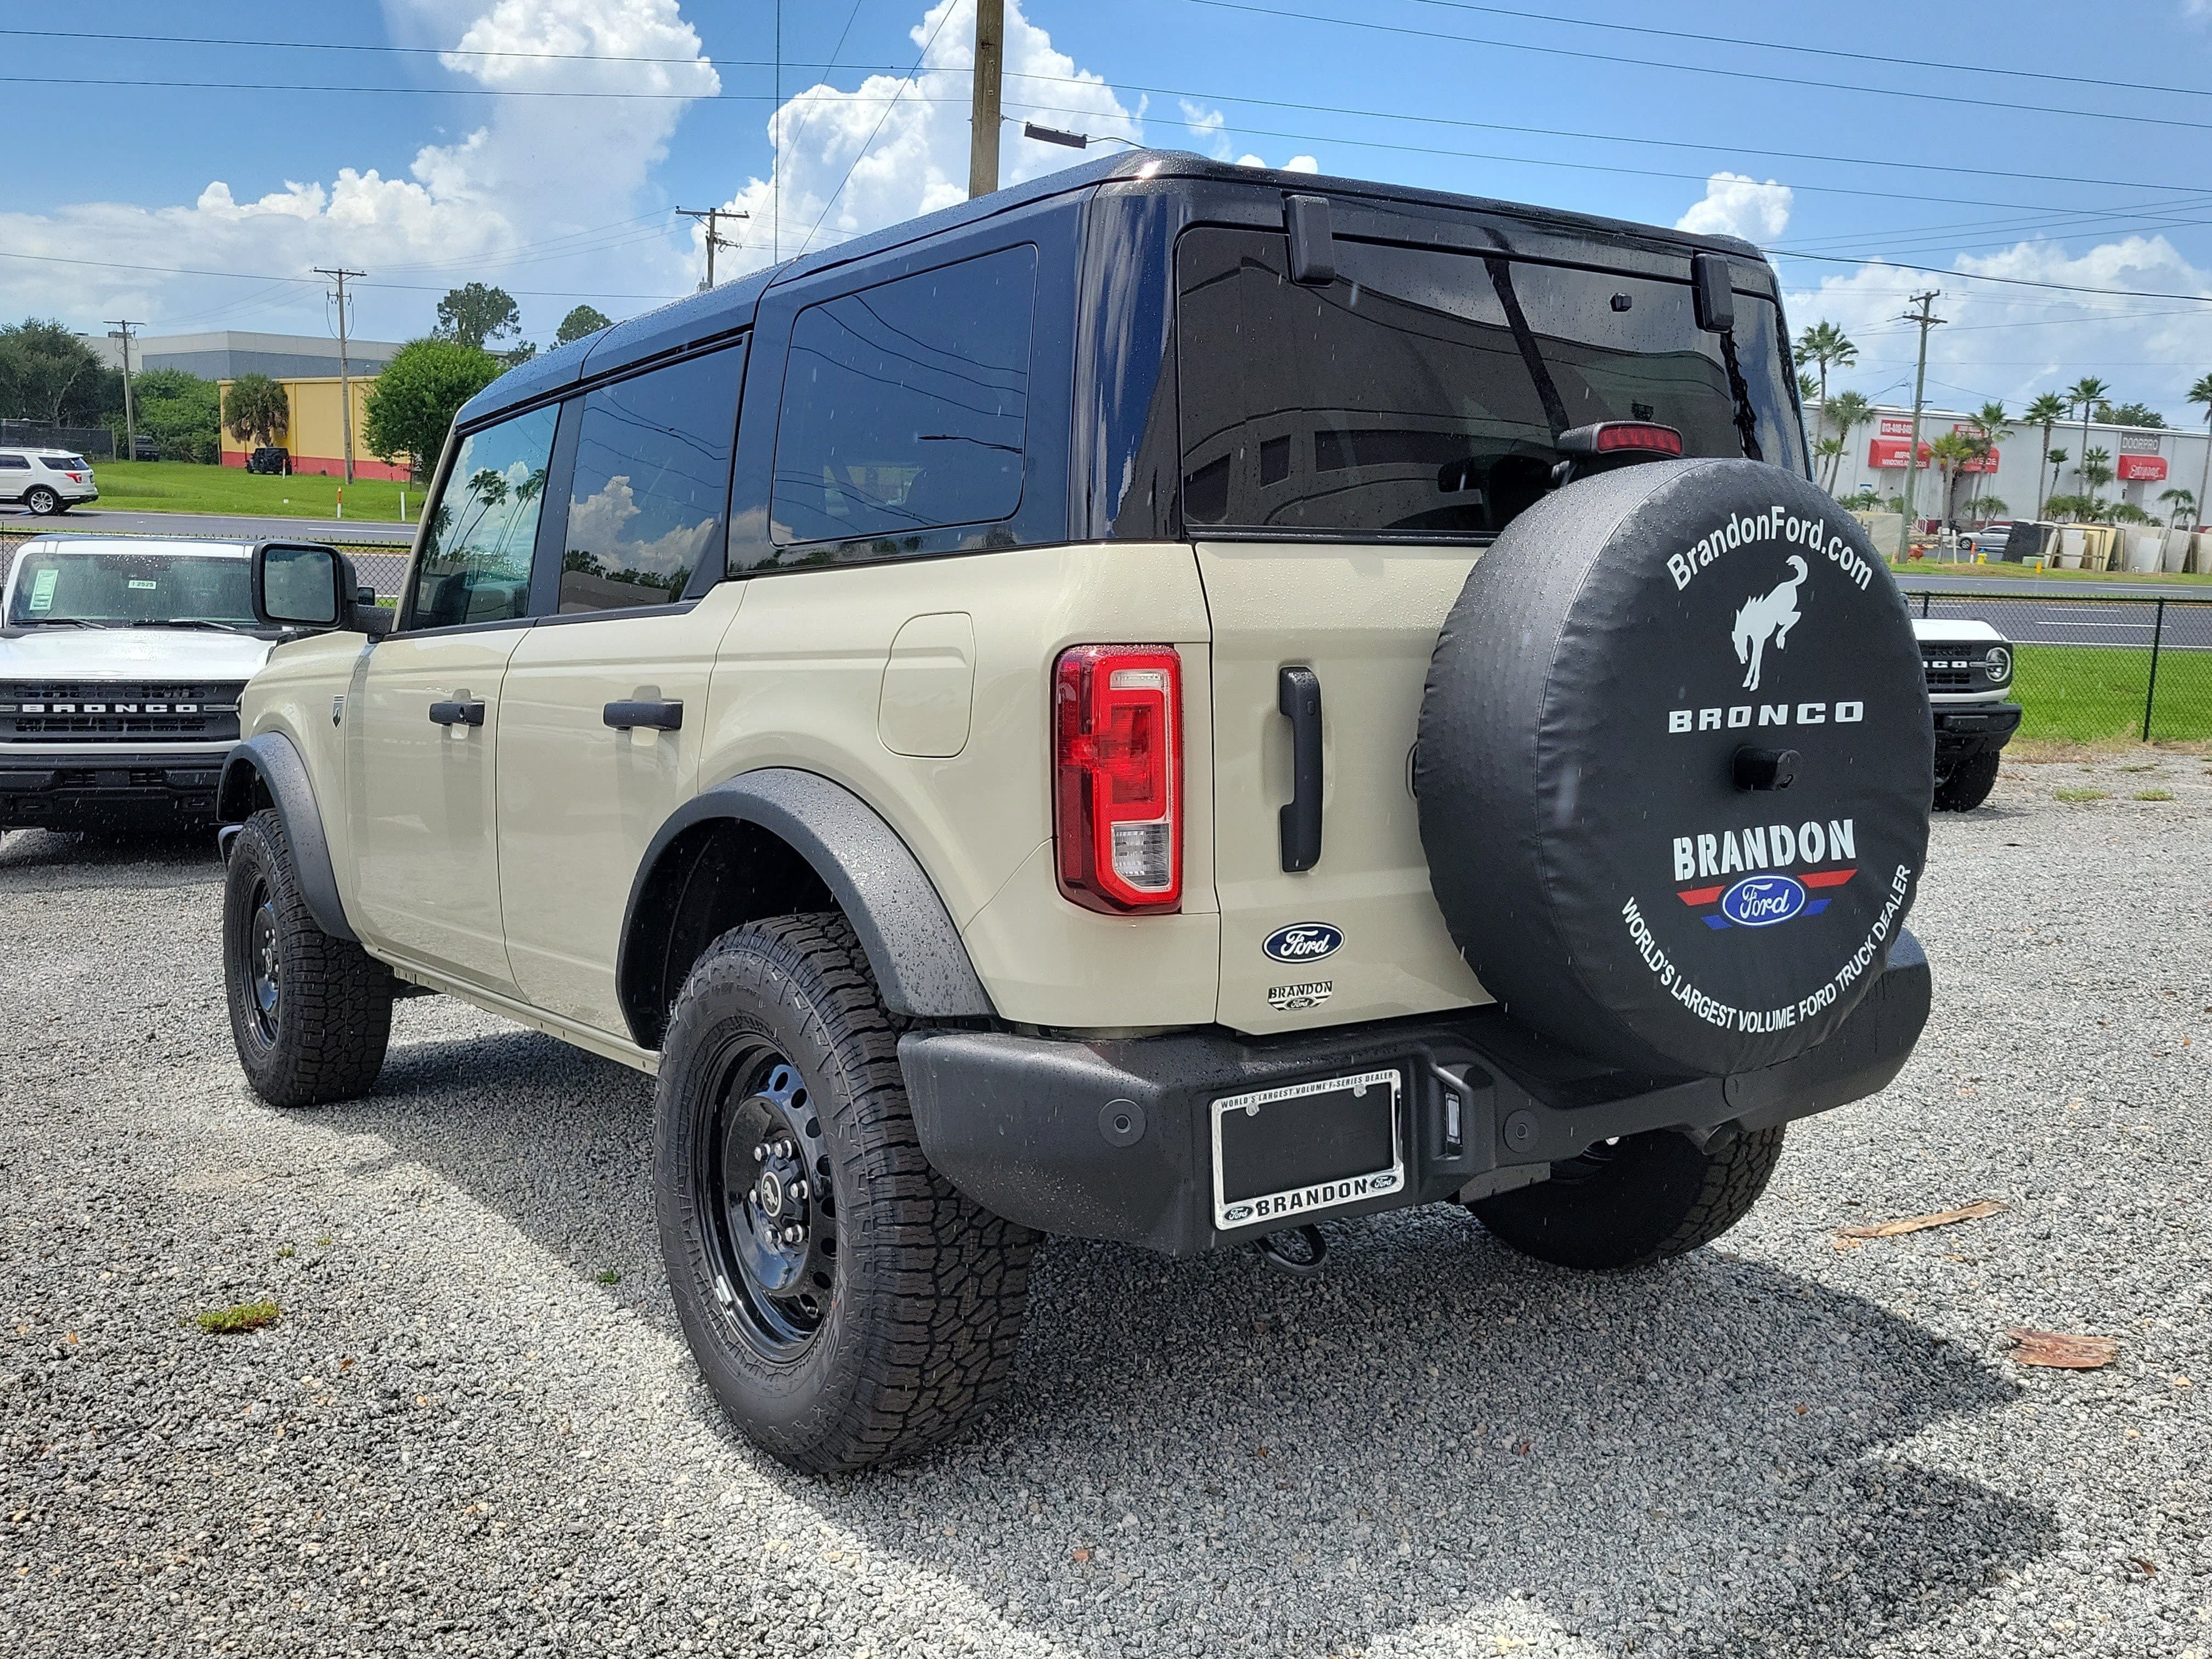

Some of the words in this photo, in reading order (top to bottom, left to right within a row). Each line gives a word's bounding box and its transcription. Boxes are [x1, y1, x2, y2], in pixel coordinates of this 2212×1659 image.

[2123, 437, 2158, 450] DOORPRO
[1667, 505, 1874, 591] BrandonFord.com
[22, 704, 198, 713] BRONCO
[1669, 701, 1864, 733] BRONCO
[1673, 819, 1856, 882] BRANDON
[1739, 883, 1790, 919] Ford
[1279, 929, 1331, 957] Ford
[1622, 896, 1674, 986] WORLD'S
[1671, 975, 1736, 1030] LARGEST
[1739, 1005, 1796, 1034] VOLUME
[1799, 983, 1837, 1022] FORD
[1835, 934, 1877, 992] TRUCK
[1872, 864, 1912, 942] DEALER
[1268, 981, 1333, 999] BRANDON
[1290, 998, 1310, 1008] Ford
[1221, 1094, 1255, 1108] WORLD'S
[1259, 1088, 1293, 1101] LARGEST
[1296, 1084, 1326, 1094] VOLUME
[1365, 1071, 1393, 1082] DEALER
[1228, 1207, 1250, 1221] Ford
[1256, 1178, 1368, 1216] BRANDON
[1373, 1174, 1394, 1189] Ford
